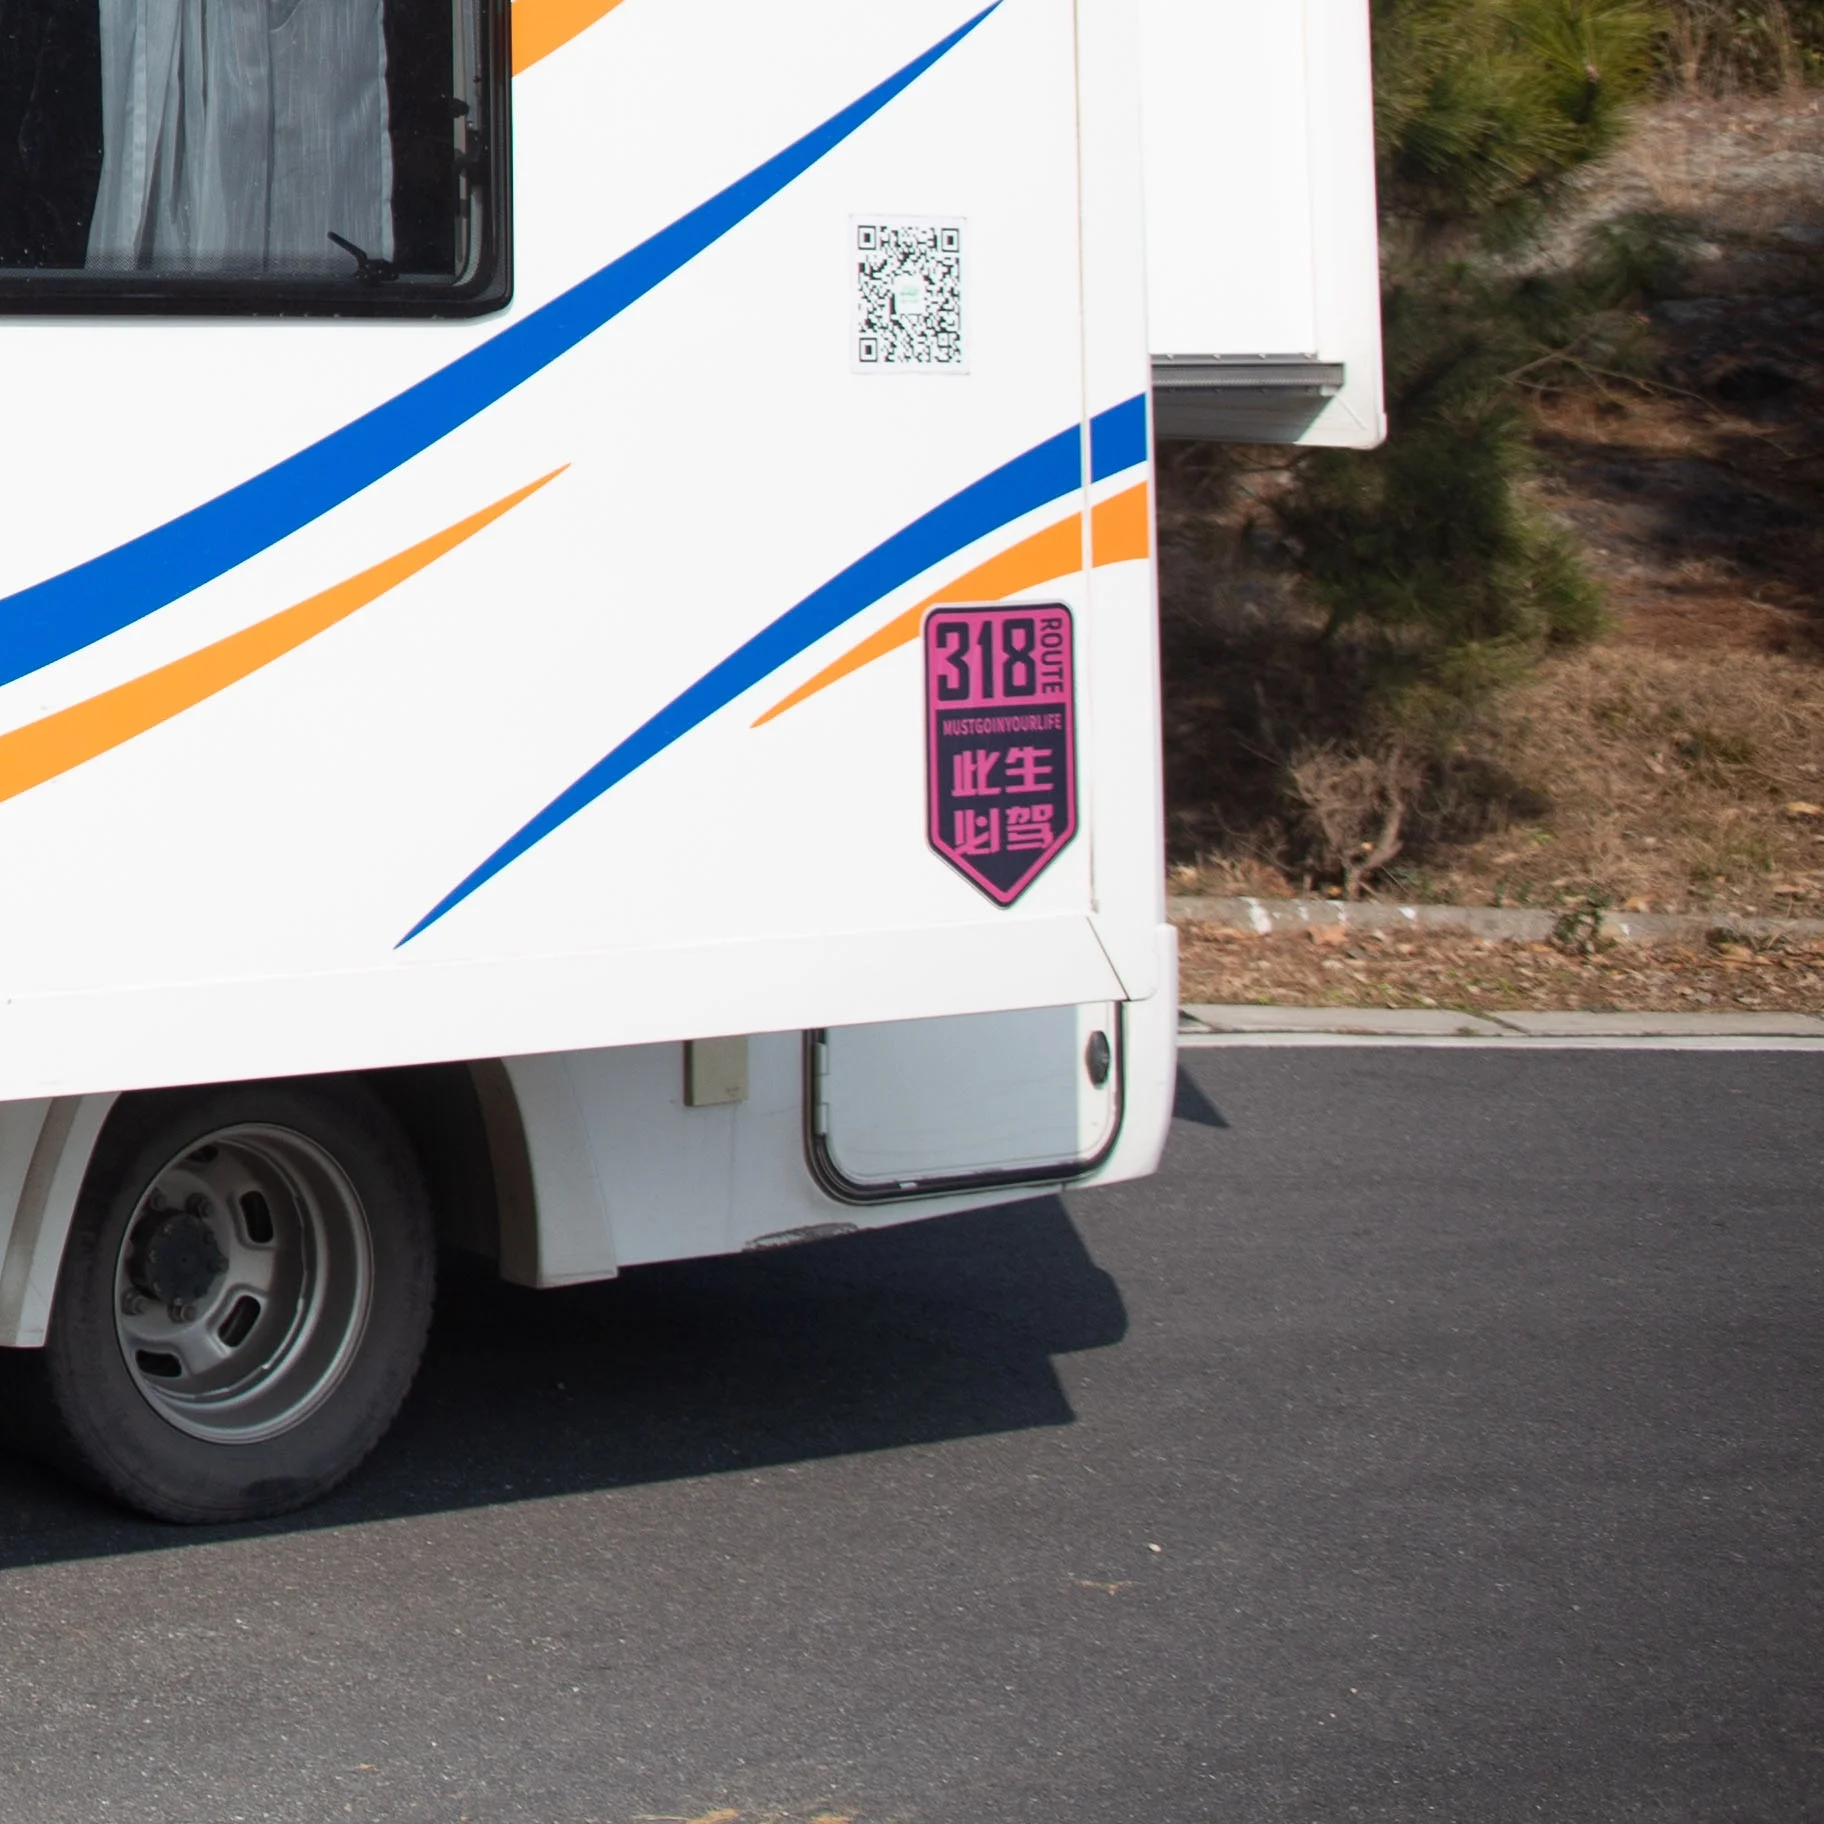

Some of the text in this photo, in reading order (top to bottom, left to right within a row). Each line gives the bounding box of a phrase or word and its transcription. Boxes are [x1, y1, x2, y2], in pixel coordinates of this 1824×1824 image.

[935, 617, 1036, 702] 318
[1039, 617, 1065, 695] ROUTE
[951, 745, 1055, 798] 此生
[952, 803, 1055, 856] 必驾
